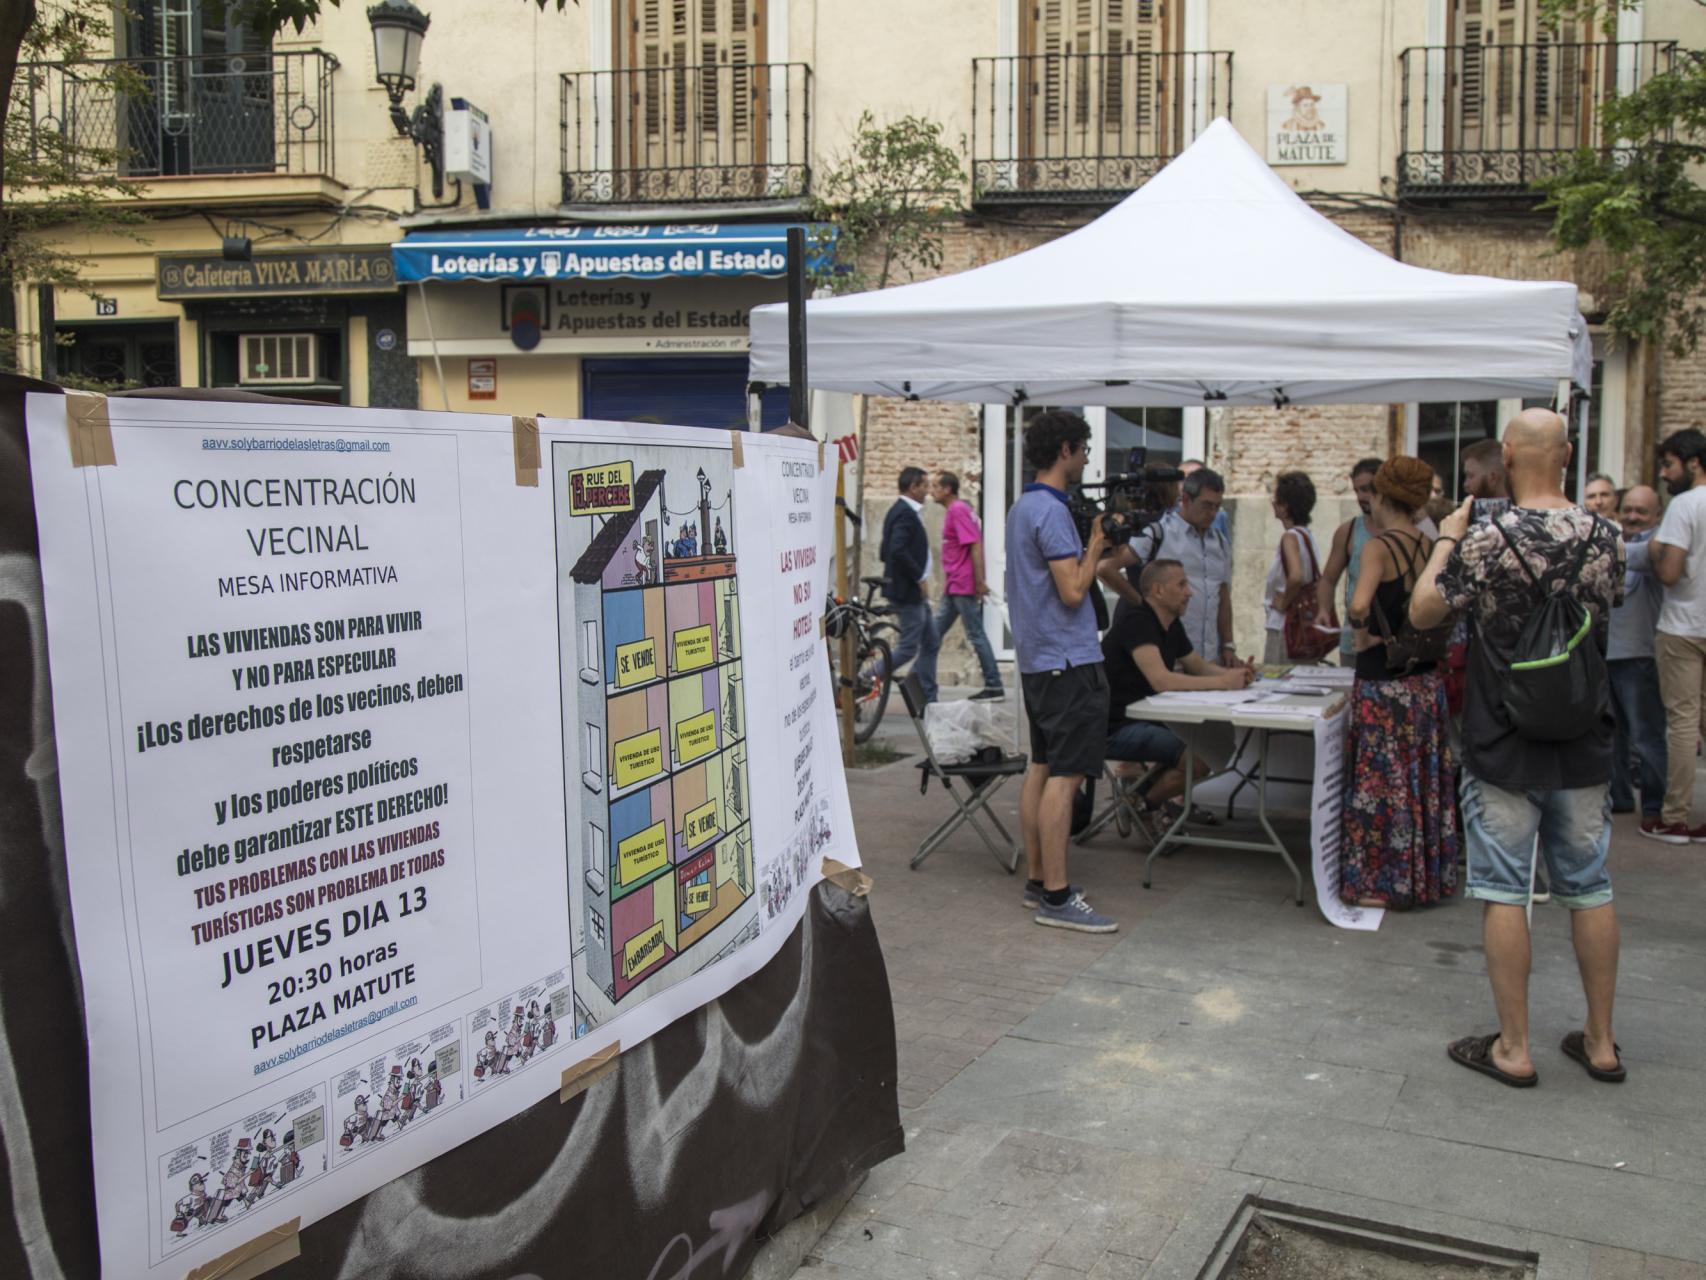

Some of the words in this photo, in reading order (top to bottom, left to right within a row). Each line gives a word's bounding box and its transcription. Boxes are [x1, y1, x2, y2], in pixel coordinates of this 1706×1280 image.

[1277, 132, 1321, 145] PLAZA
[1278, 145, 1337, 160] MATUTE
[255, 262, 301, 284] VIVA
[305, 254, 371, 283] MARÍA
[431, 252, 519, 274] Loterías
[523, 256, 537, 277] y
[564, 252, 665, 277] Apuestas
[669, 250, 703, 271] del
[710, 249, 785, 270] Estado
[556, 289, 634, 308] Loterías
[640, 292, 652, 310] y
[558, 311, 647, 334] Apuestas
[652, 310, 681, 330] del
[655, 339, 727, 349] Administración
[201, 436, 391, 453] aavv.solybarriodelasletras@gmail.com
[173, 471, 417, 510] CONCENTRACIÓN
[586, 472, 605, 486] RUE
[608, 469, 623, 484] DEL
[586, 484, 630, 508] PERCEBE
[246, 524, 369, 557] VECINAL
[780, 550, 793, 573] LAS
[218, 574, 275, 598] MESA
[280, 564, 398, 593] INFORMATIVA
[187, 632, 221, 659] LAS
[223, 623, 312, 652] VIVIENDAS
[314, 619, 345, 643] SON
[348, 615, 385, 640] PARA
[386, 610, 423, 633] VIVIR
[232, 668, 245, 691] Y
[247, 664, 270, 690] NO
[273, 659, 314, 685] PARA
[317, 647, 397, 679] ESPECULAR
[620, 655, 631, 674] SE
[632, 647, 655, 670] VENDE
[137, 719, 183, 753] ¡Los
[187, 704, 285, 741] derechos
[289, 697, 313, 723] de
[316, 693, 344, 718] los
[346, 682, 415, 713] vecinos,
[416, 673, 464, 700] deben
[272, 728, 373, 768] respetarse
[619, 750, 643, 763] VIVIENDA
[643, 748, 650, 756] DE
[650, 745, 660, 754] USO
[215, 800, 228, 826] y
[231, 792, 262, 819] los
[266, 774, 344, 814] poderes
[347, 756, 418, 795] políticos
[176, 844, 230, 877] debe
[234, 817, 332, 863] garantizar
[335, 803, 374, 835] ESTE
[377, 782, 449, 824] DERECHO!
[688, 820, 696, 839] SE
[698, 811, 717, 834] VENDE
[623, 845, 647, 859] VIVIENDA
[647, 842, 654, 850] DE
[655, 838, 665, 847] USO
[194, 883, 227, 910] TUS
[229, 856, 317, 900] PROBLEMAS
[320, 847, 349, 873] CON
[351, 840, 376, 864] LAS
[377, 821, 440, 857] VIVIENDAS
[191, 899, 284, 946] TURÍSTICAS
[286, 890, 316, 917] SON
[317, 867, 388, 906] PROBLEMA
[390, 864, 405, 886] DE
[407, 849, 446, 878] TODAS
[688, 892, 694, 905] SE
[695, 890, 709, 903] VENDE
[220, 918, 332, 989] JUEVES
[342, 900, 390, 939] DIA
[398, 885, 428, 919] 13
[628, 929, 664, 973] EMBARGADO
[267, 962, 333, 1006] 20:30
[339, 941, 399, 977] horas
[250, 1001, 327, 1050] PLAZA
[332, 963, 417, 1016] MATUTE
[253, 993, 418, 1077] aavv.solybarriodelasletras@gmail.com
